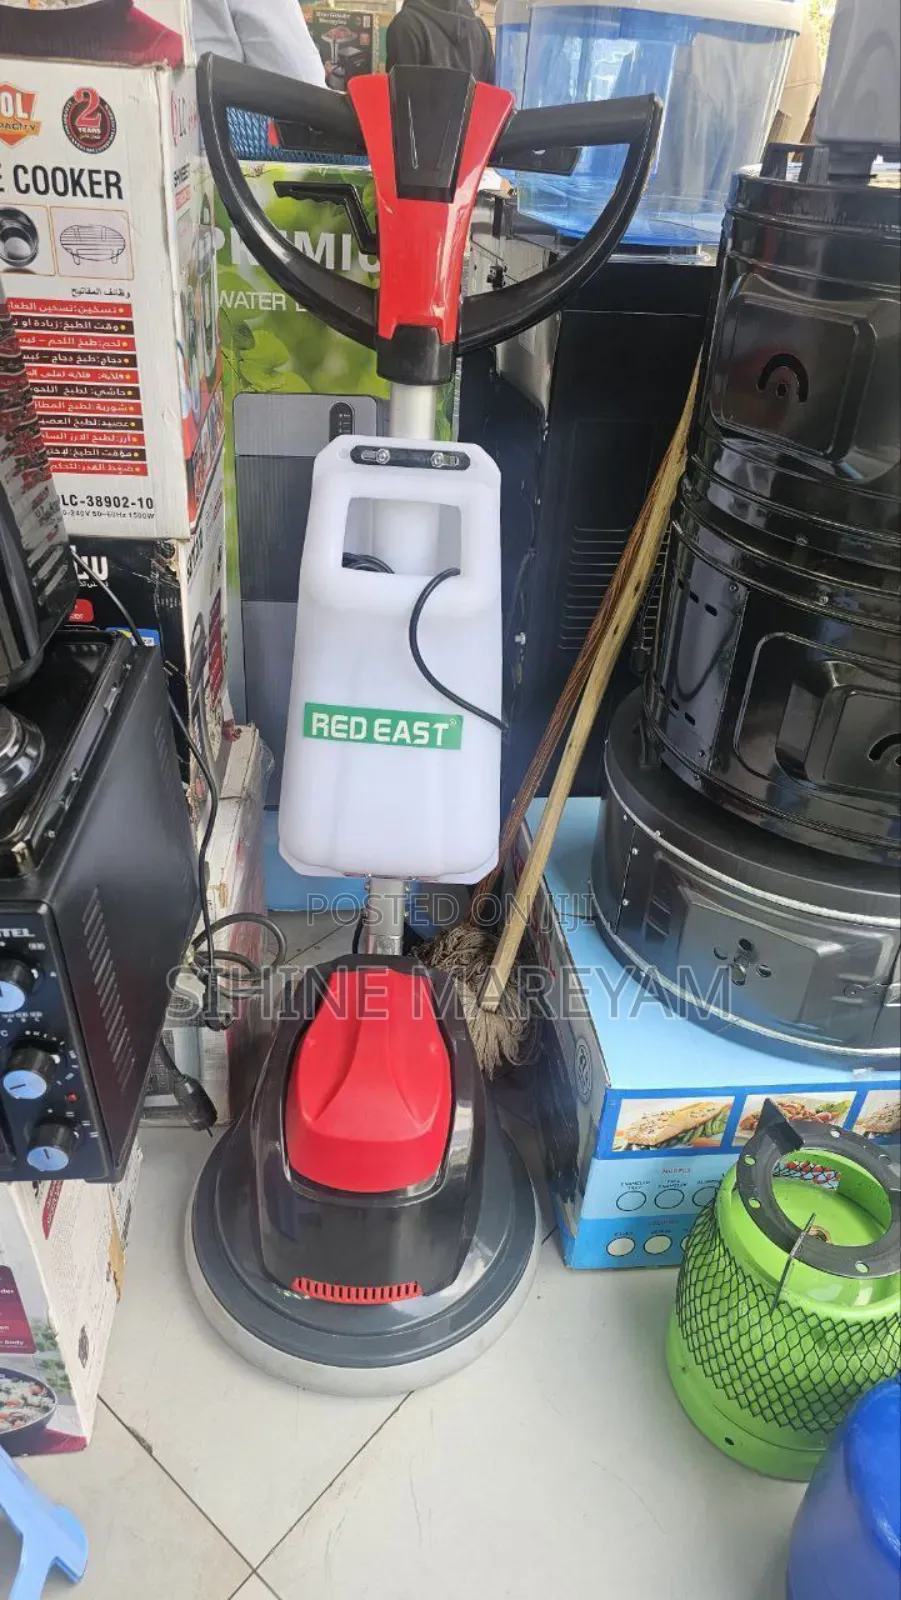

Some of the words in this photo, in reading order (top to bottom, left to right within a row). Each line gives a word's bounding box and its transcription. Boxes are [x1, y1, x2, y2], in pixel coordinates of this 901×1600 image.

[73, 87, 102, 127] 2
[13, 164, 123, 200] COOKER
[219, 289, 286, 311] WATER
[61, 494, 154, 509] LC-38902-10
[311, 712, 367, 740] RED
